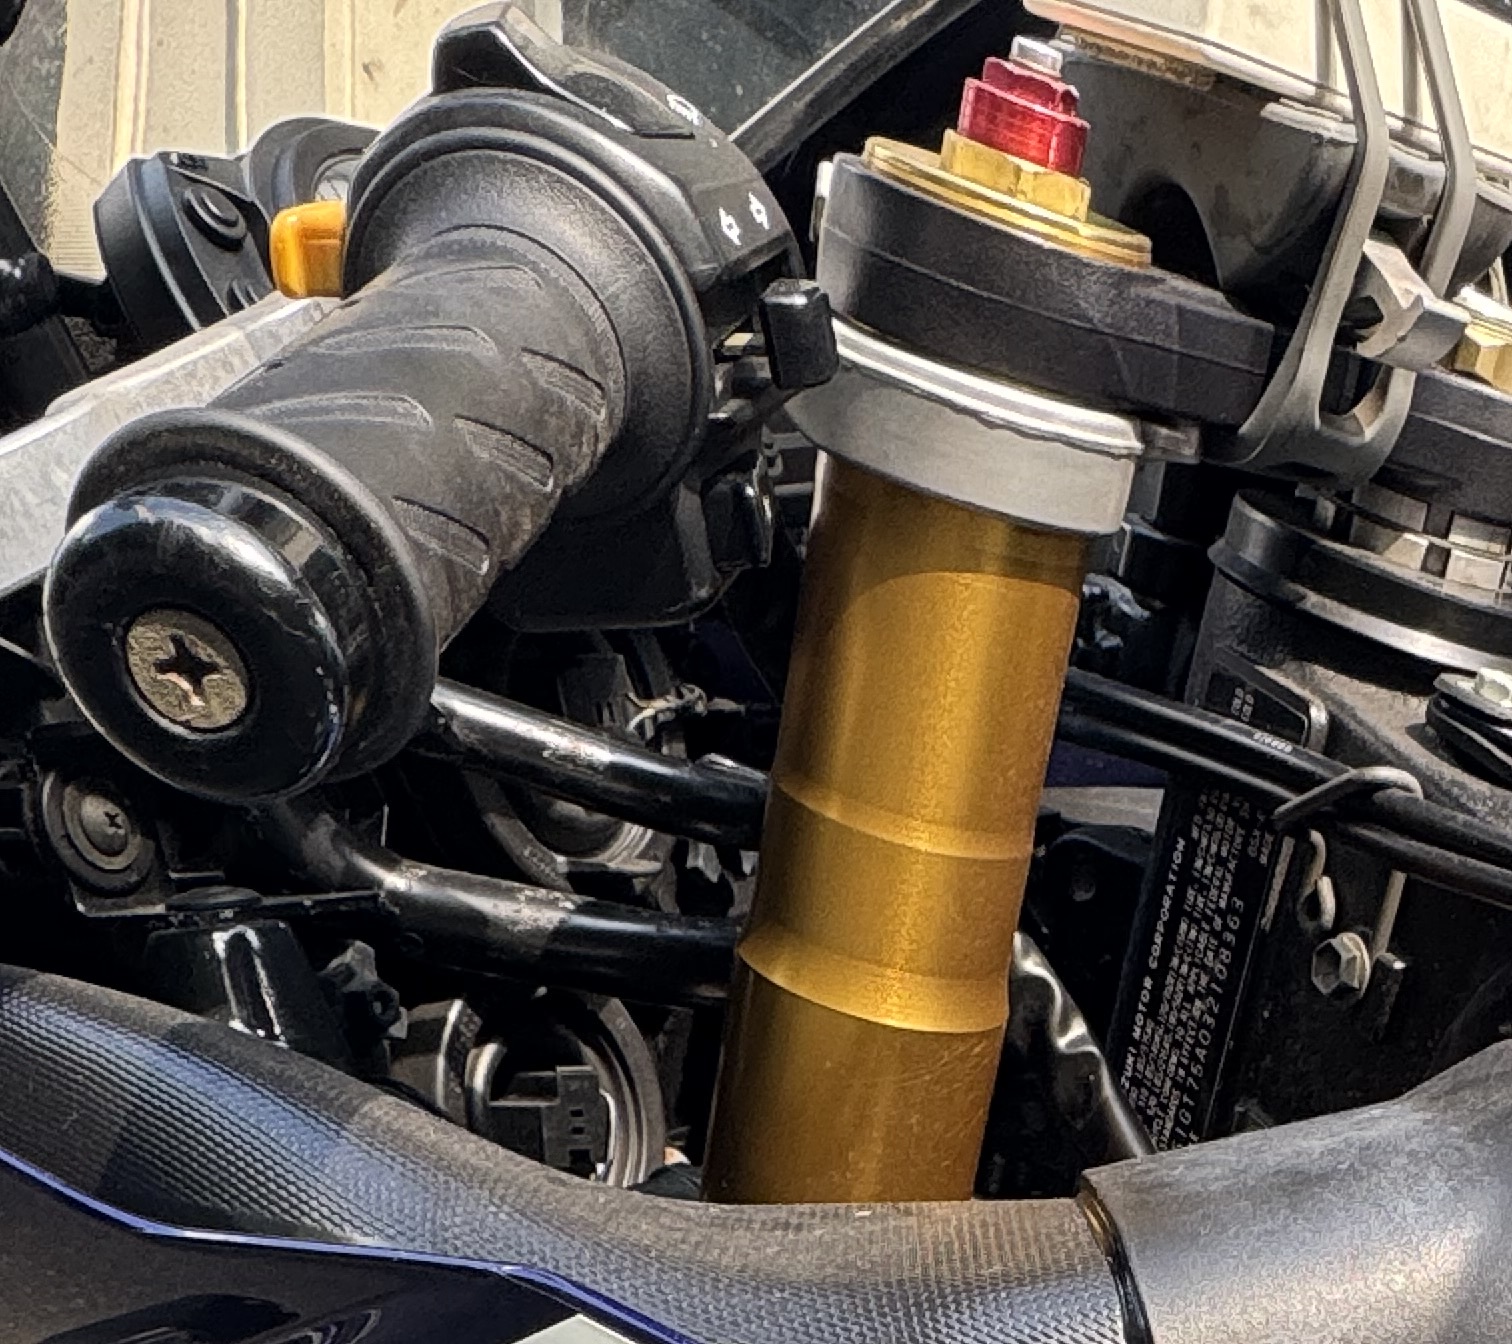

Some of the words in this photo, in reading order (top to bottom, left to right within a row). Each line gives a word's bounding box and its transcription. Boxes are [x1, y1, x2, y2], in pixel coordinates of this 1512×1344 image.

[1131, 975, 1153, 1041] MOTOR
[1147, 836, 1186, 969] CORPORATION
[1172, 896, 1245, 1146] 1GT75A032108363
